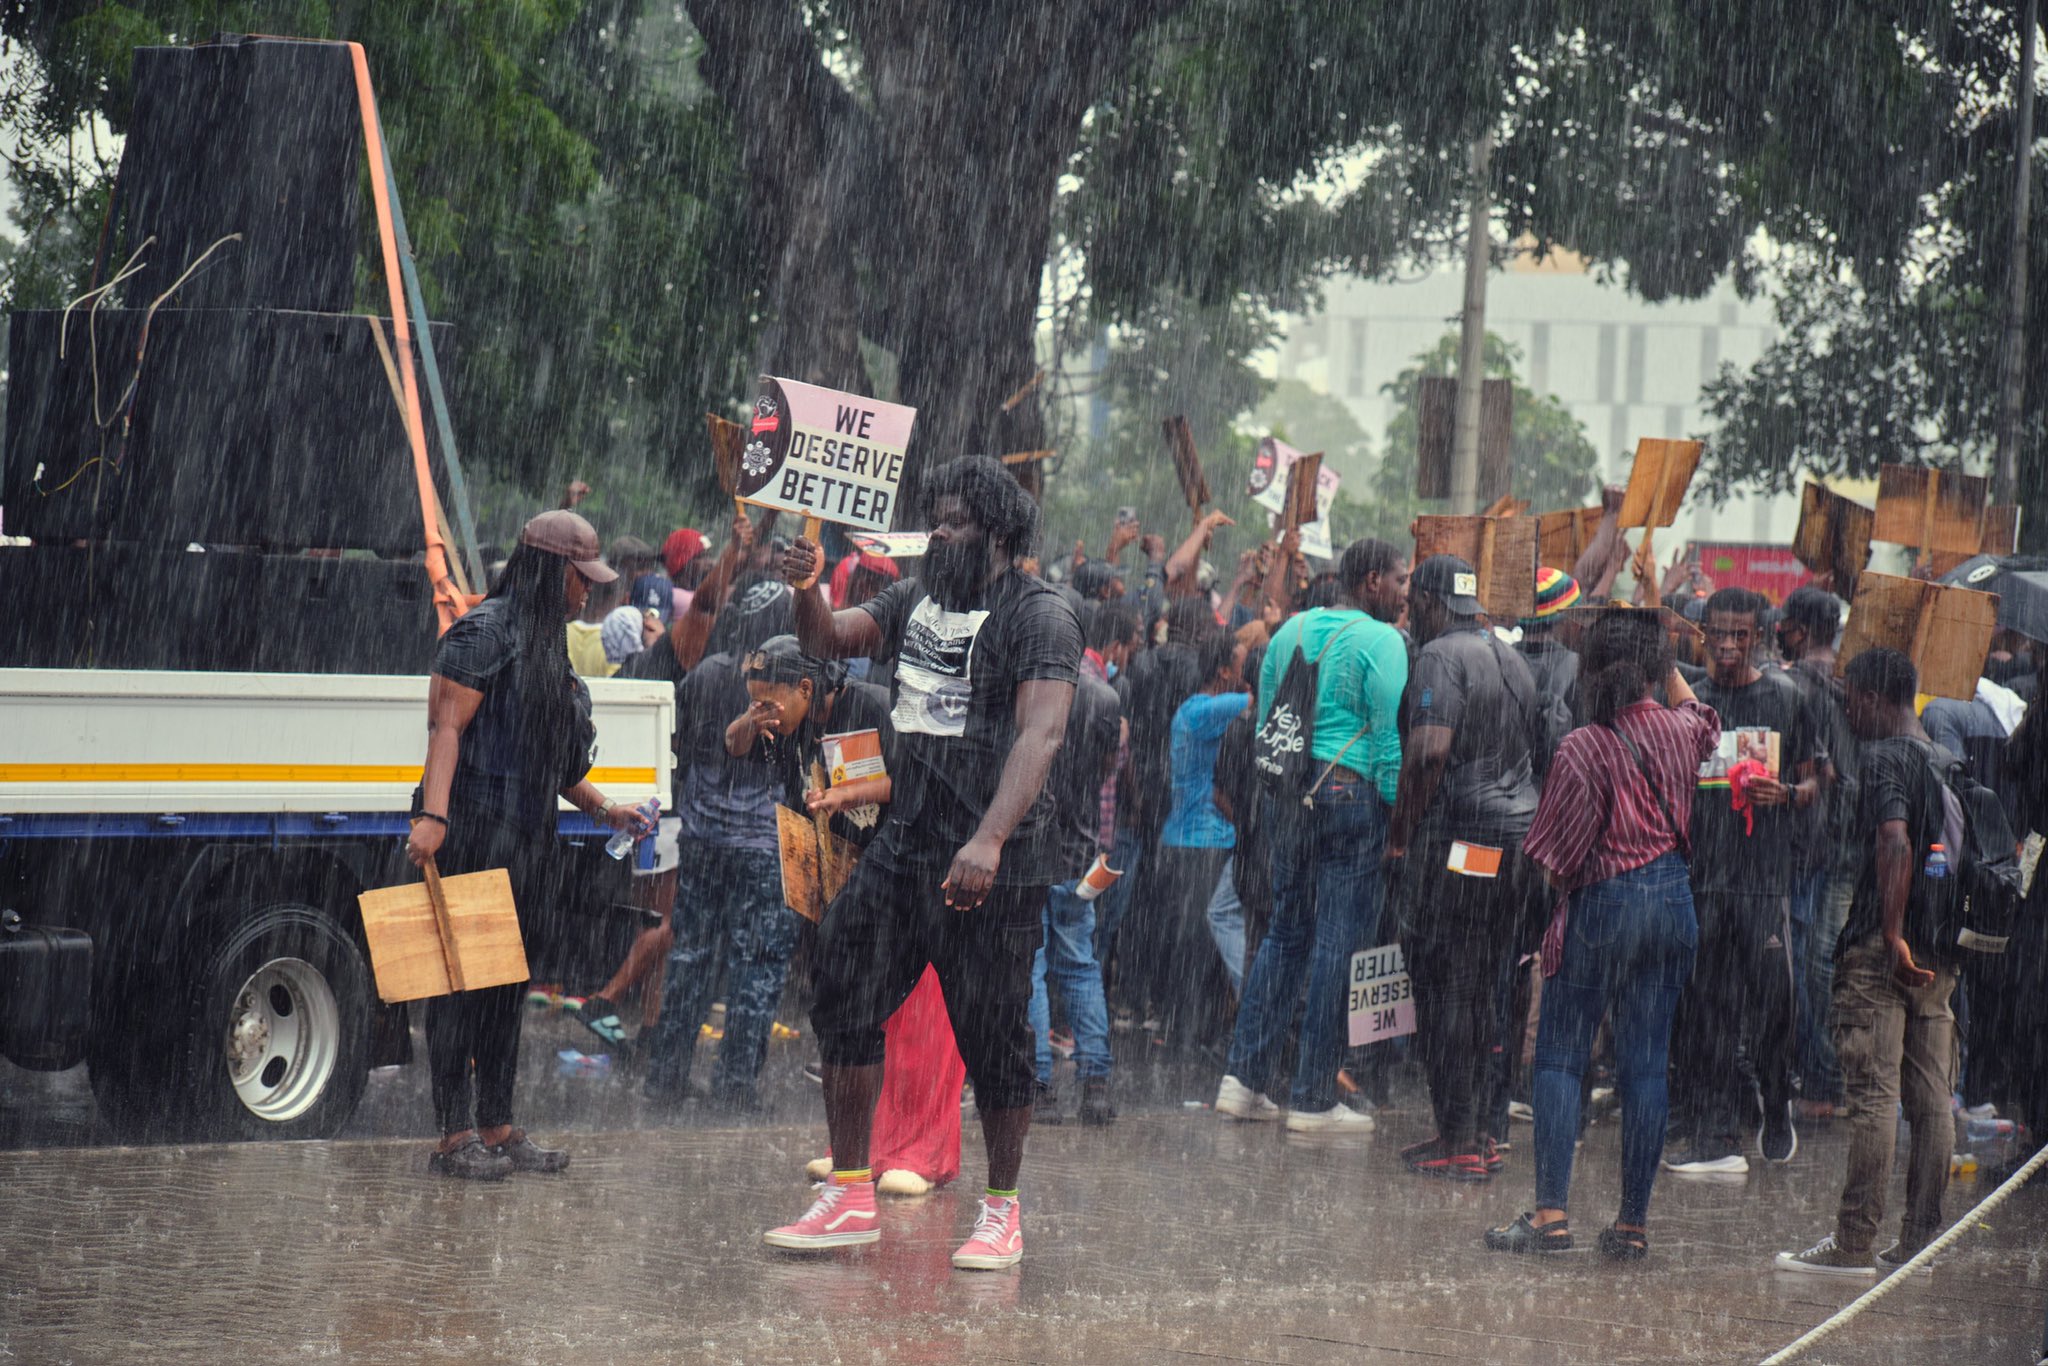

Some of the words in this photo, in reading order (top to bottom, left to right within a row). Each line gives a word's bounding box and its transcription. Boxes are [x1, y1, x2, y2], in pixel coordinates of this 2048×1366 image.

[835, 404, 875, 440] WE
[789, 430, 903, 483] DESERVE
[779, 467, 889, 524] BETTER
[1354, 951, 1406, 982] TTER
[1350, 979, 1410, 1012] ESERVE
[1373, 1008, 1397, 1032] WE
